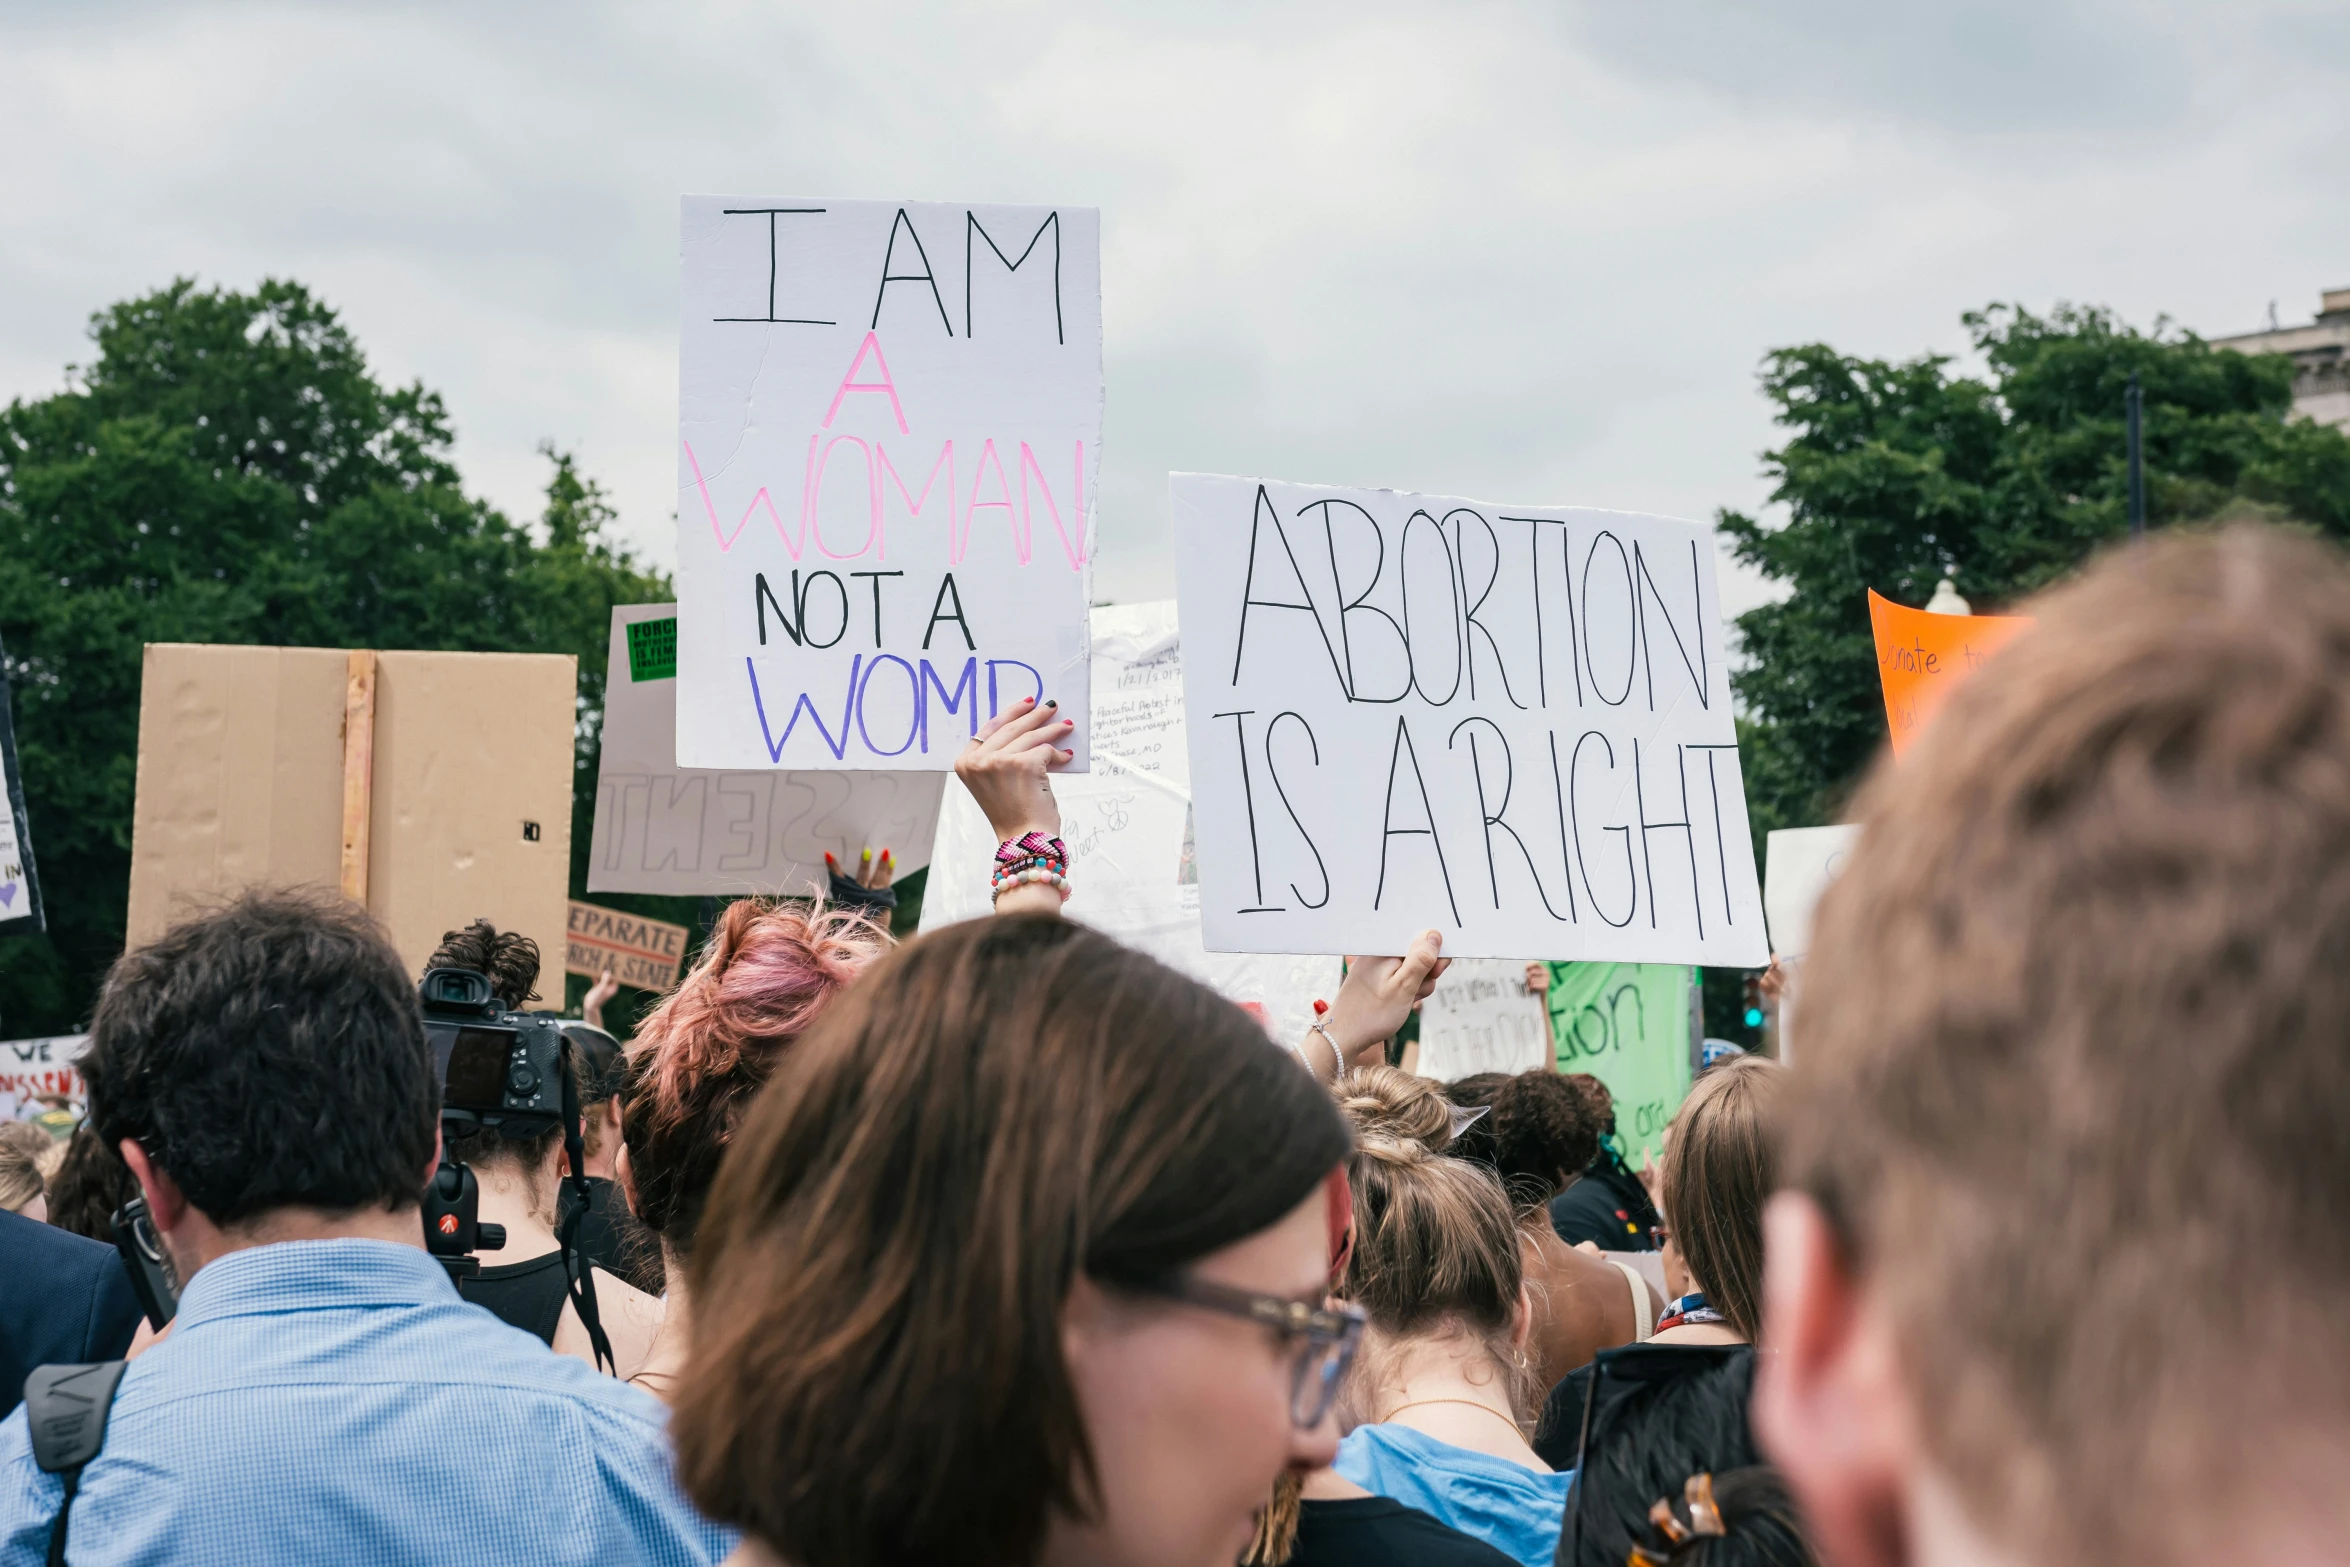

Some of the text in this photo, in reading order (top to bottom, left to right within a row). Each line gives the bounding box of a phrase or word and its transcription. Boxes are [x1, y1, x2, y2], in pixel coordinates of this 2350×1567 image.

[713, 207, 1064, 346] I AM
[820, 331, 911, 436] A
[683, 433, 1089, 573] WOMAN
[754, 569, 978, 651] NOT A
[1232, 483, 1710, 712] ABORTION
[633, 635, 677, 648] MOTHERH
[650, 644, 677, 657] FEM
[1091, 711, 1153, 730] ighborhoods
[1091, 729, 1118, 741] stices
[1111, 747, 1142, 758] hase,
[1211, 710, 1739, 942] IS A RIGHT
[567, 906, 682, 957] EPARATE
[12, 1042, 53, 1063] WE
